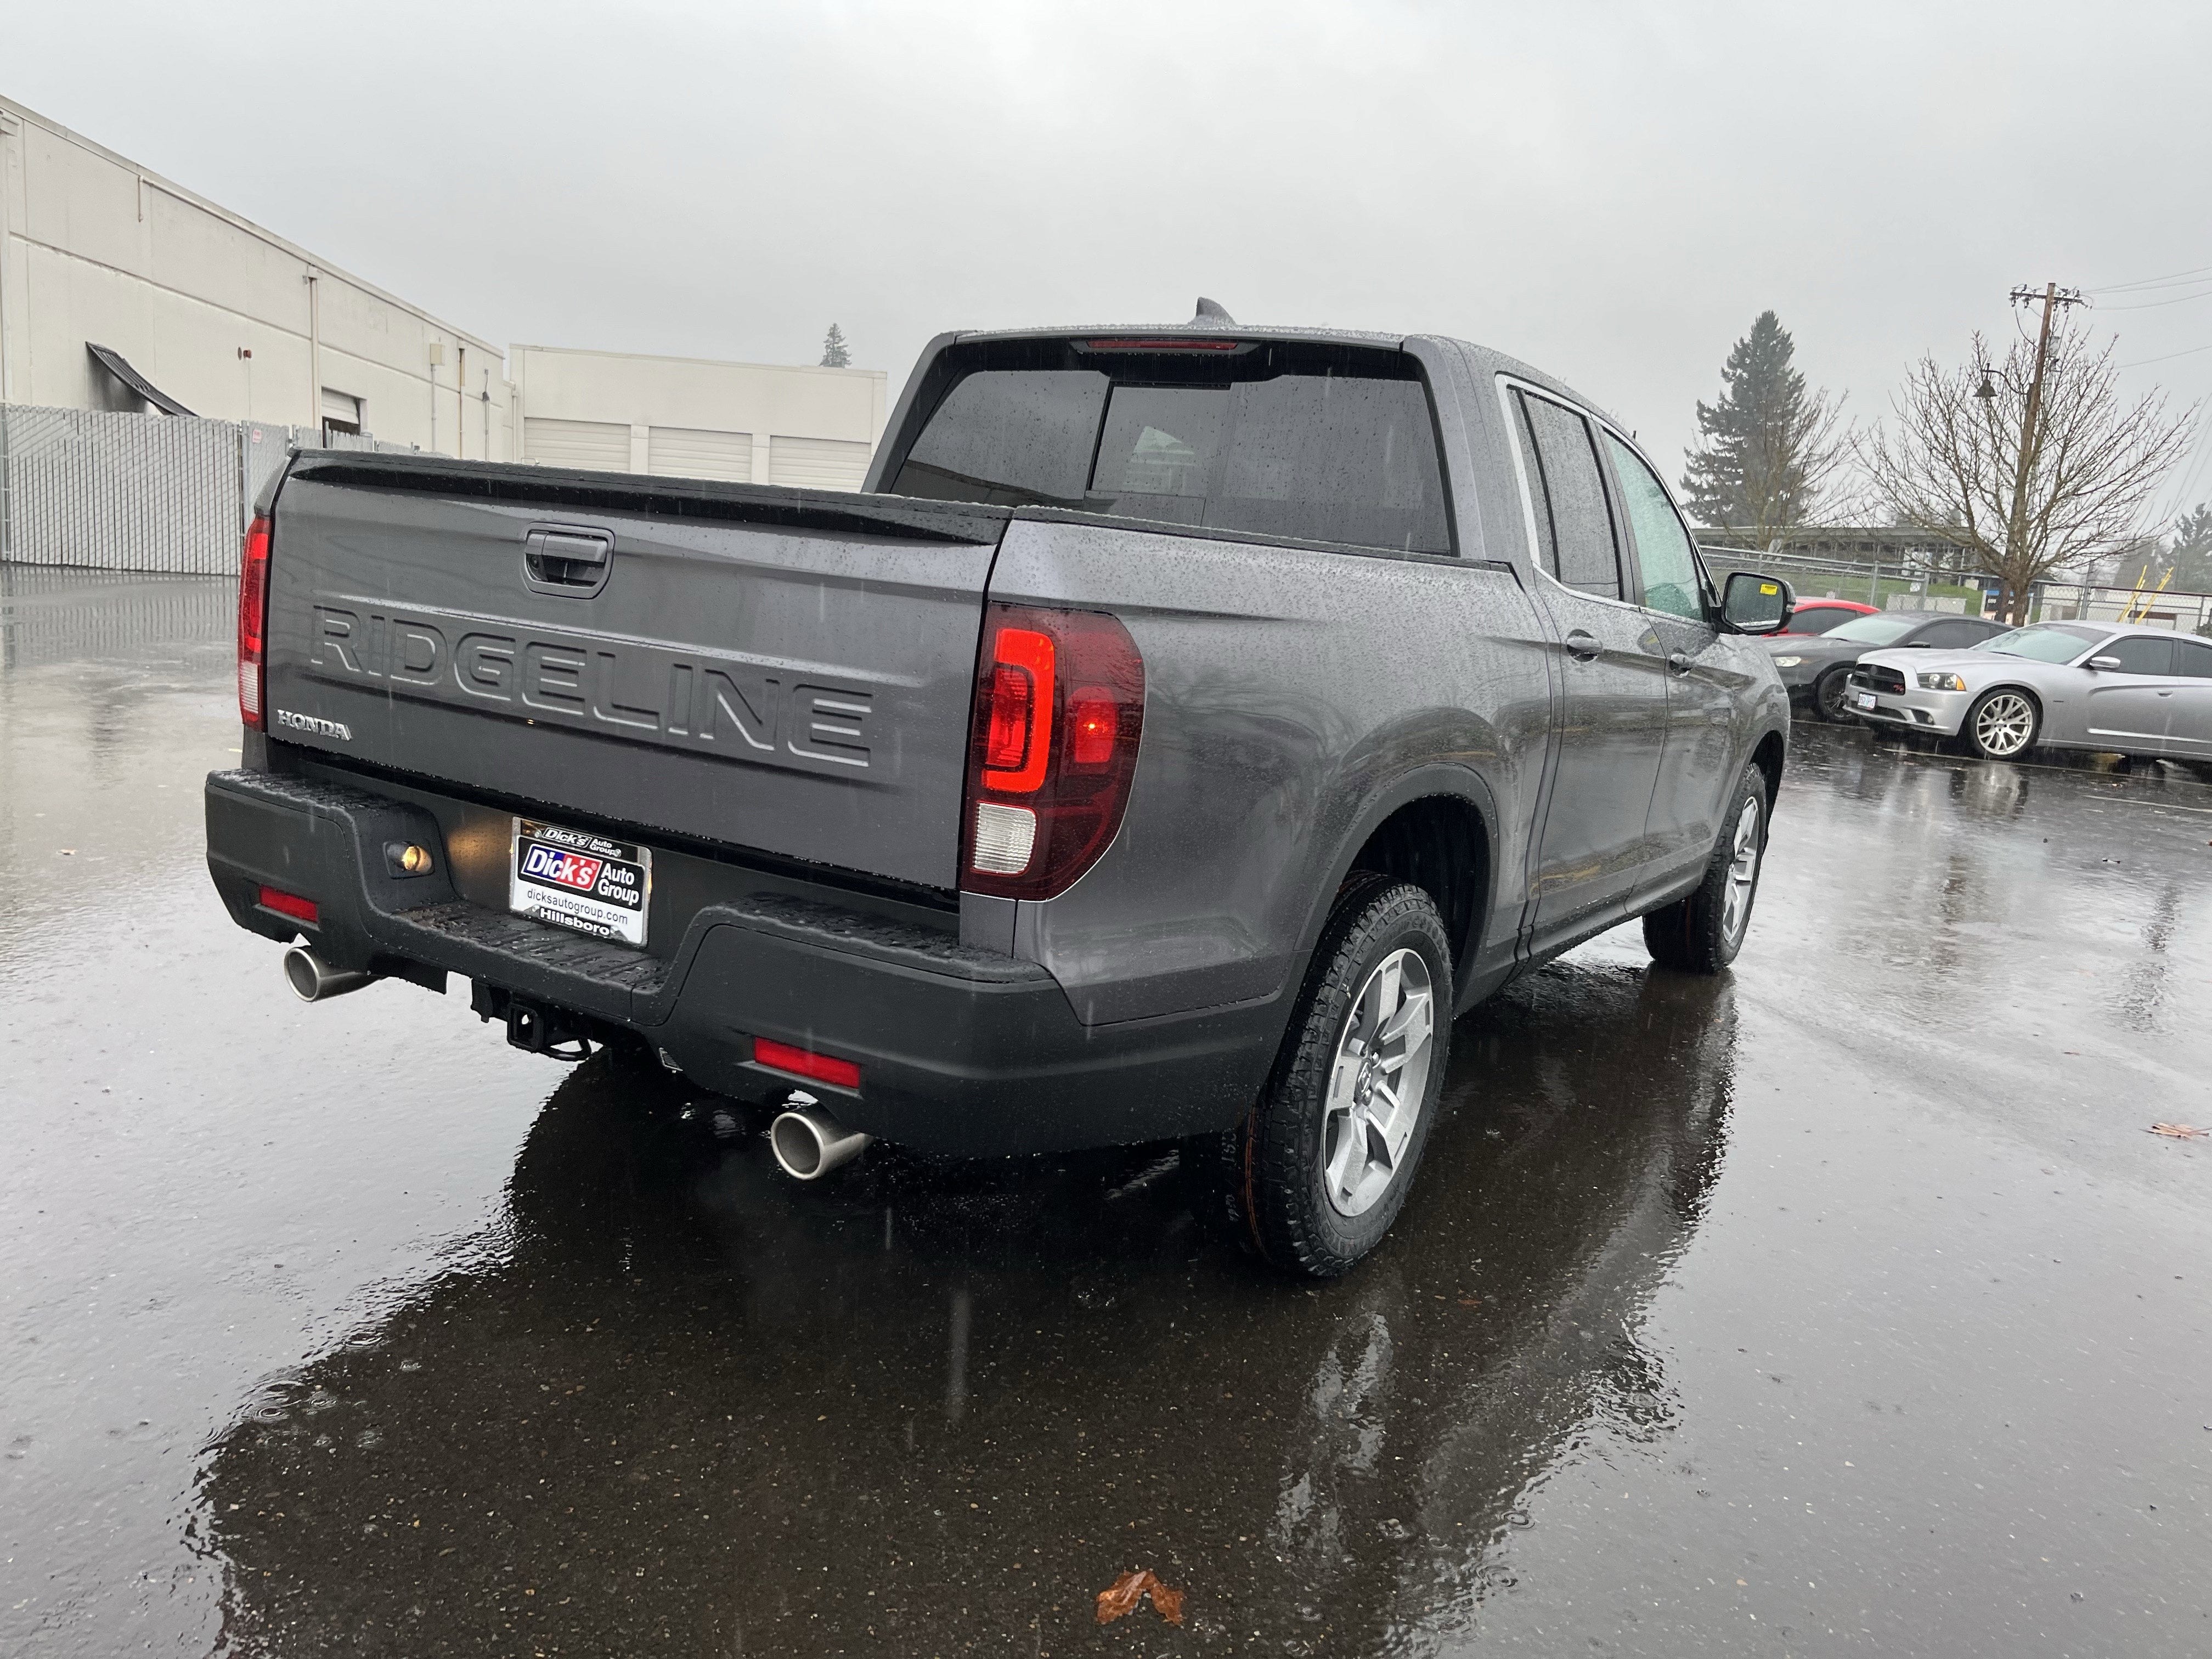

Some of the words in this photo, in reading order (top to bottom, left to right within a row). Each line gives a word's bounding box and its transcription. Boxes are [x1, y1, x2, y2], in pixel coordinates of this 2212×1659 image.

[311, 605, 874, 767] RIDGELINE
[277, 709, 352, 741] HONDA
[545, 829, 589, 847] Dick's
[591, 839, 613, 849] Auto
[527, 849, 594, 885] Dick's
[601, 862, 634, 885] Auto
[527, 888, 628, 925] dicksautogroup.com
[598, 879, 639, 905] Group
[540, 907, 611, 936] Hillsboro
